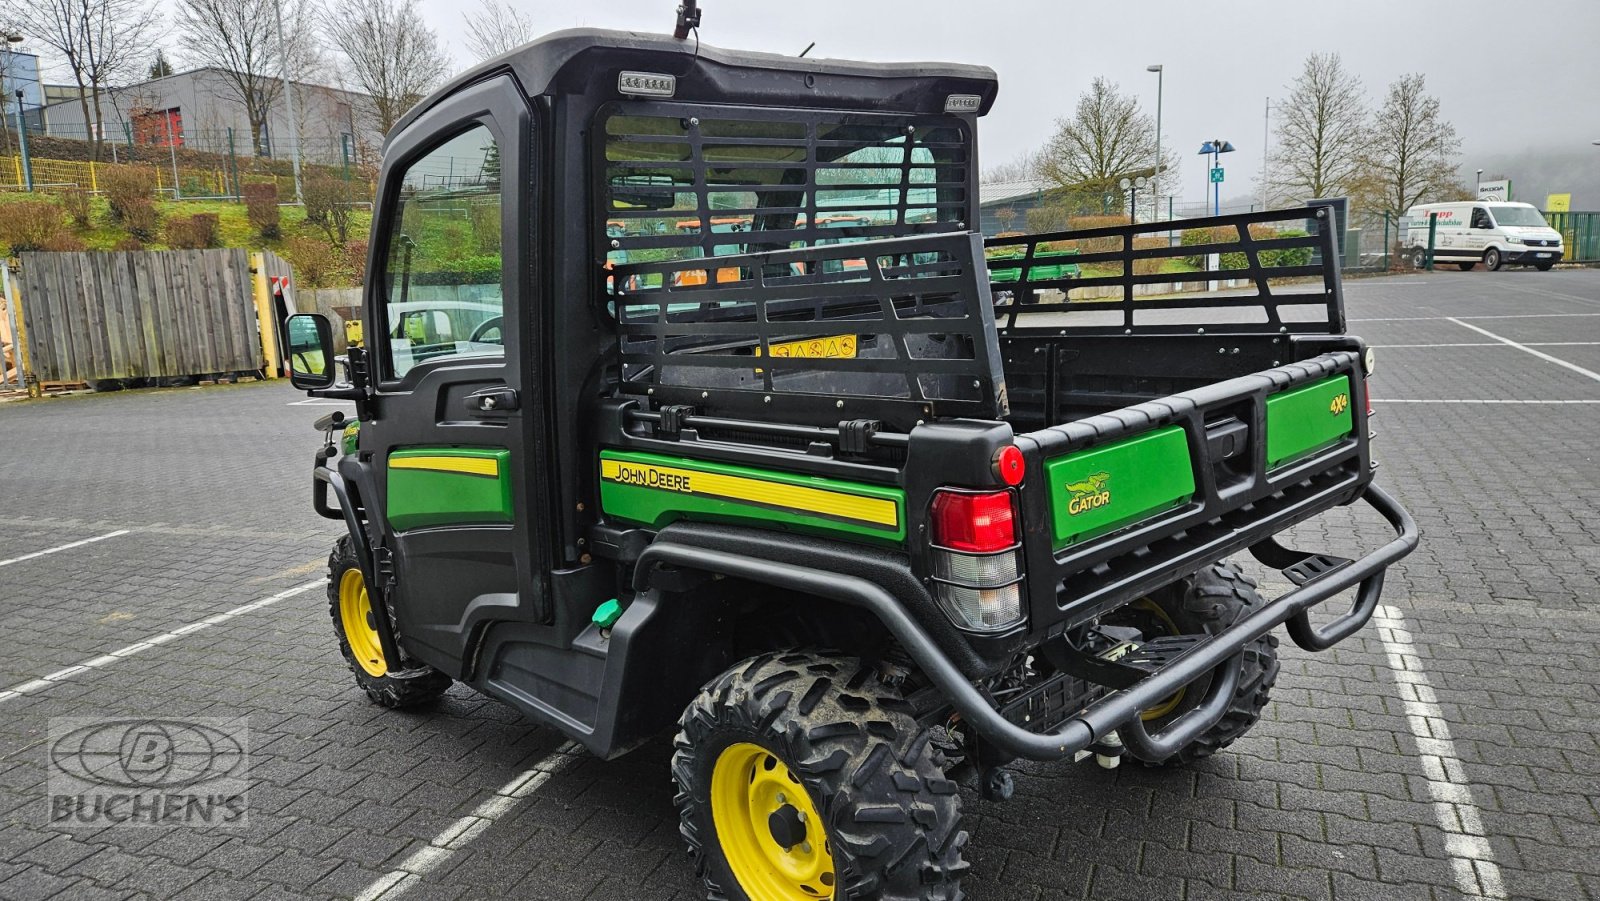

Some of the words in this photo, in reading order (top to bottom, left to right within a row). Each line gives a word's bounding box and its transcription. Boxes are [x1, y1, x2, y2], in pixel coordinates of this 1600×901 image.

[615, 464, 647, 484] JOHN
[649, 468, 691, 490] DEERE
[1068, 491, 1110, 515] GATOR
